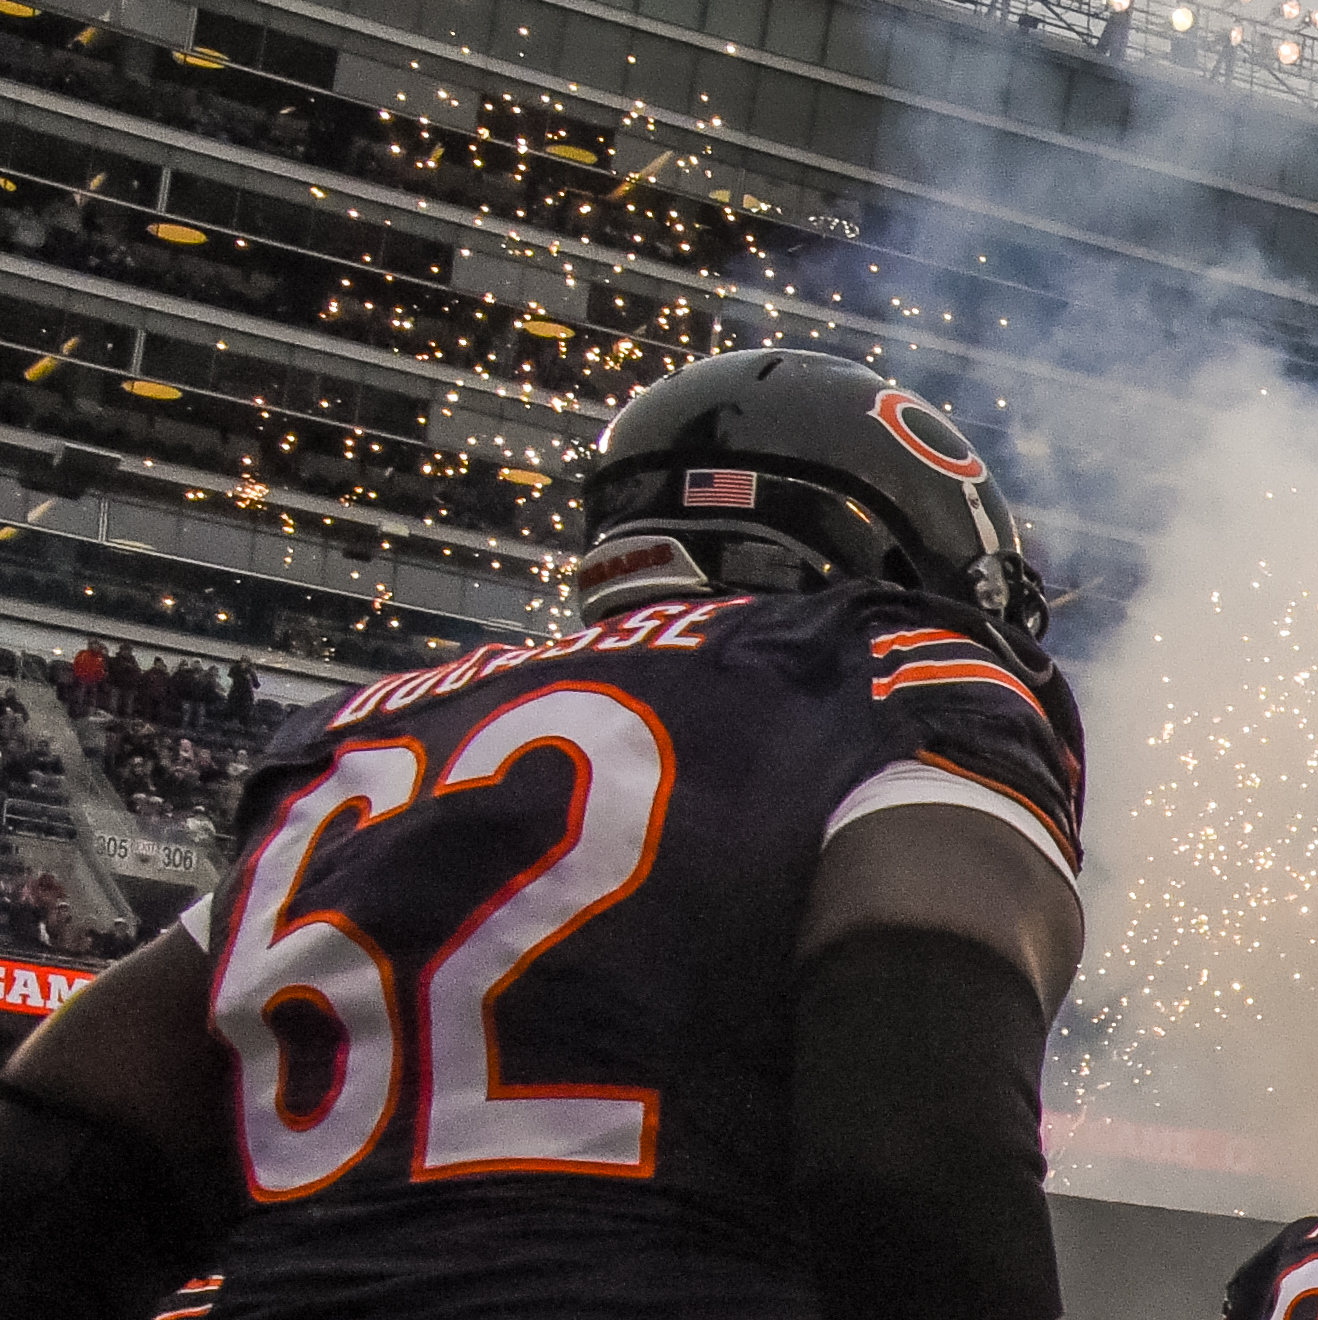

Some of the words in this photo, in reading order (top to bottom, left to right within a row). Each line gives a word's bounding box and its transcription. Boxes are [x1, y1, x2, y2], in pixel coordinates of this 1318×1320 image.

[162, 846, 193, 870] 306
[208, 680, 676, 1203] 62
[0, 966, 93, 1010] AM
